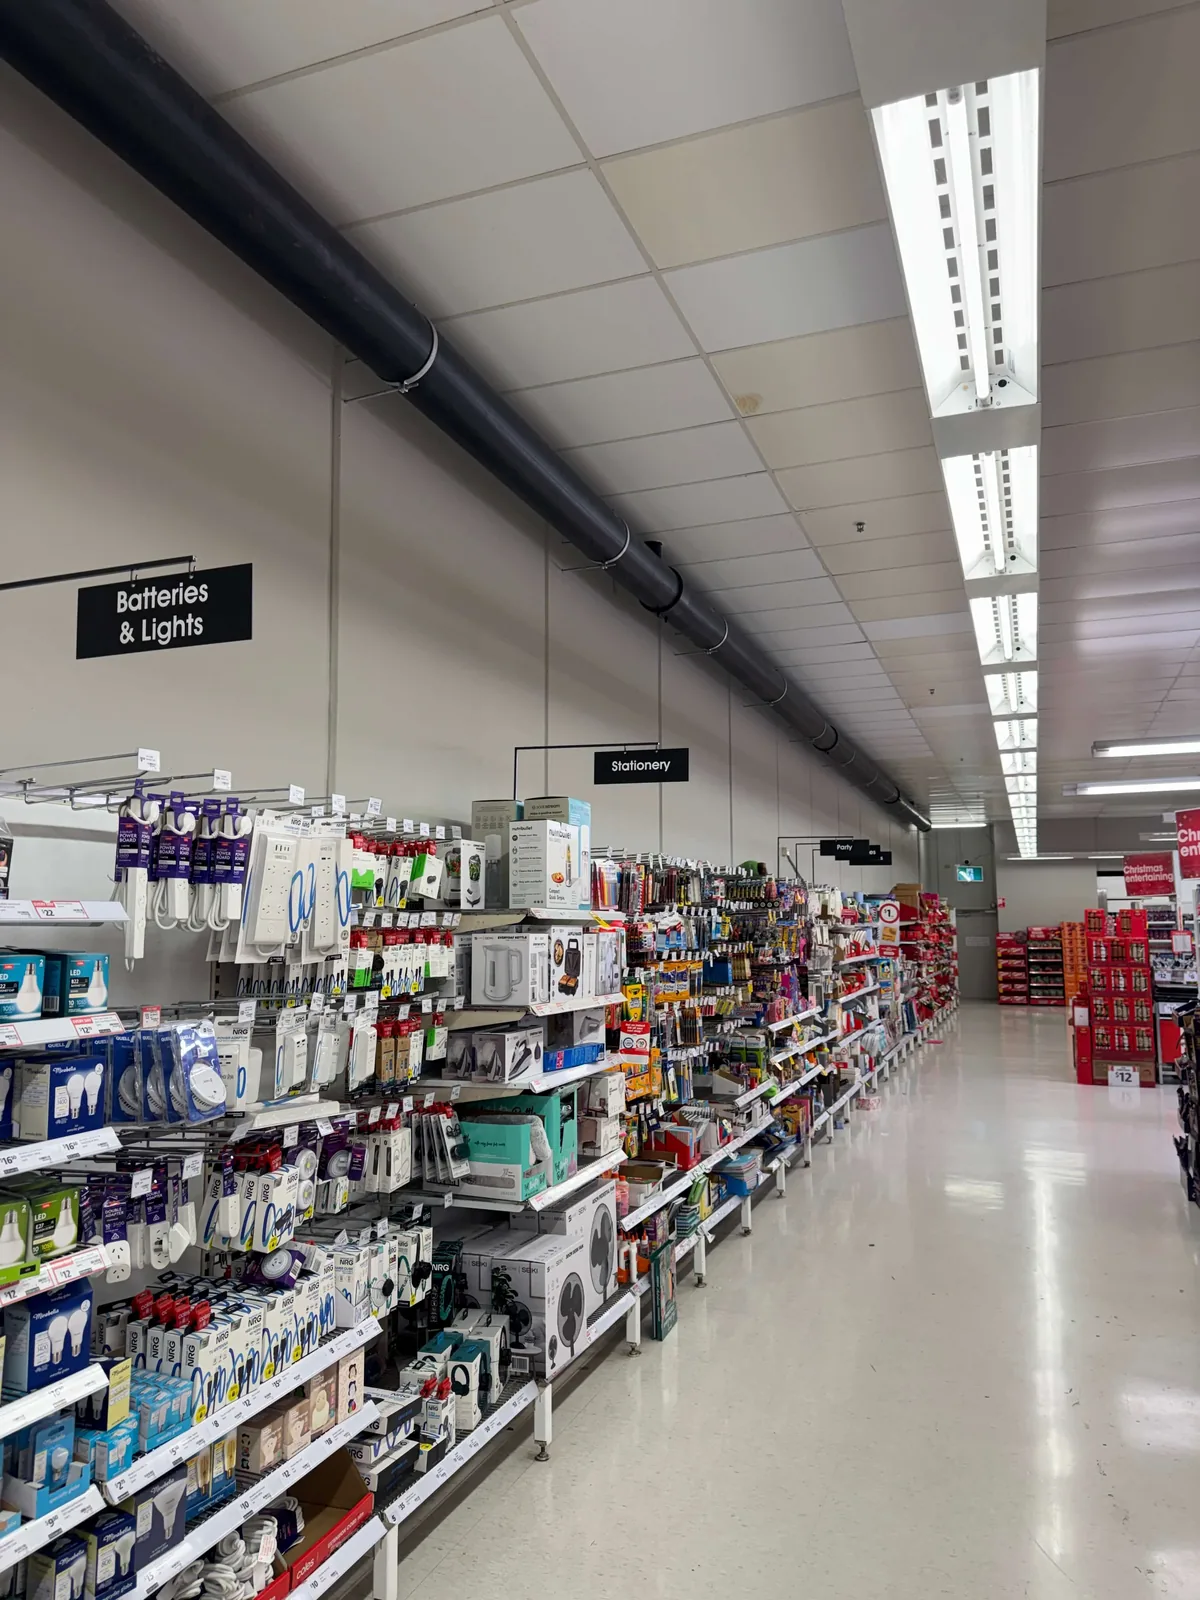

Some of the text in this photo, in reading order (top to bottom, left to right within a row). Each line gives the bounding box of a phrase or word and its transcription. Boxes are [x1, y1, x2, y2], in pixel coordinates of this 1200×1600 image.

[116, 582, 209, 614] Batteries
[119, 613, 204, 646] & Lights
[611, 758, 671, 773] Stationery
[836, 844, 853, 852] Party
[1123, 864, 1163, 875] Christmas
[1125, 873, 1174, 883] entertaining
[52, 1066, 77, 1074] Mirabella
[1115, 1071, 1133, 1083] $12
[287, 1173, 298, 1184] NRG
[211, 1179, 222, 1199] NRG
[245, 1180, 255, 1200] NRG
[262, 1183, 270, 1203] NRG
[34, 1212, 47, 1221] LED
[323, 1264, 334, 1274] NRG
[432, 1263, 450, 1272] NRG
[471, 1260, 488, 1268] SEIKI
[521, 1266, 539, 1274] SEIKI
[60, 1269, 72, 1279] $12
[307, 1281, 320, 1293] NRG
[4, 1290, 17, 1299] $12
[281, 1296, 294, 1308] NRG
[32, 1308, 59, 1320] Mirabella
[247, 1314, 262, 1327] NRG
[215, 1331, 230, 1344] NRG
[152, 1336, 160, 1359] NRG
[168, 1340, 176, 1362] NRG
[187, 1344, 196, 1367] NRG
[111, 1365, 130, 1376] Mirabella
[242, 1398, 251, 1407] $12
[282, 1469, 290, 1478] $12
[150, 1478, 175, 1495] Mirabella
[240, 1500, 250, 1510] $10
[391, 1514, 397, 1522] 5
[102, 1526, 132, 1542] Mirabella
[58, 1549, 85, 1565] Mirabella
[296, 1558, 315, 1580] coles
[309, 1580, 318, 1590] $10
